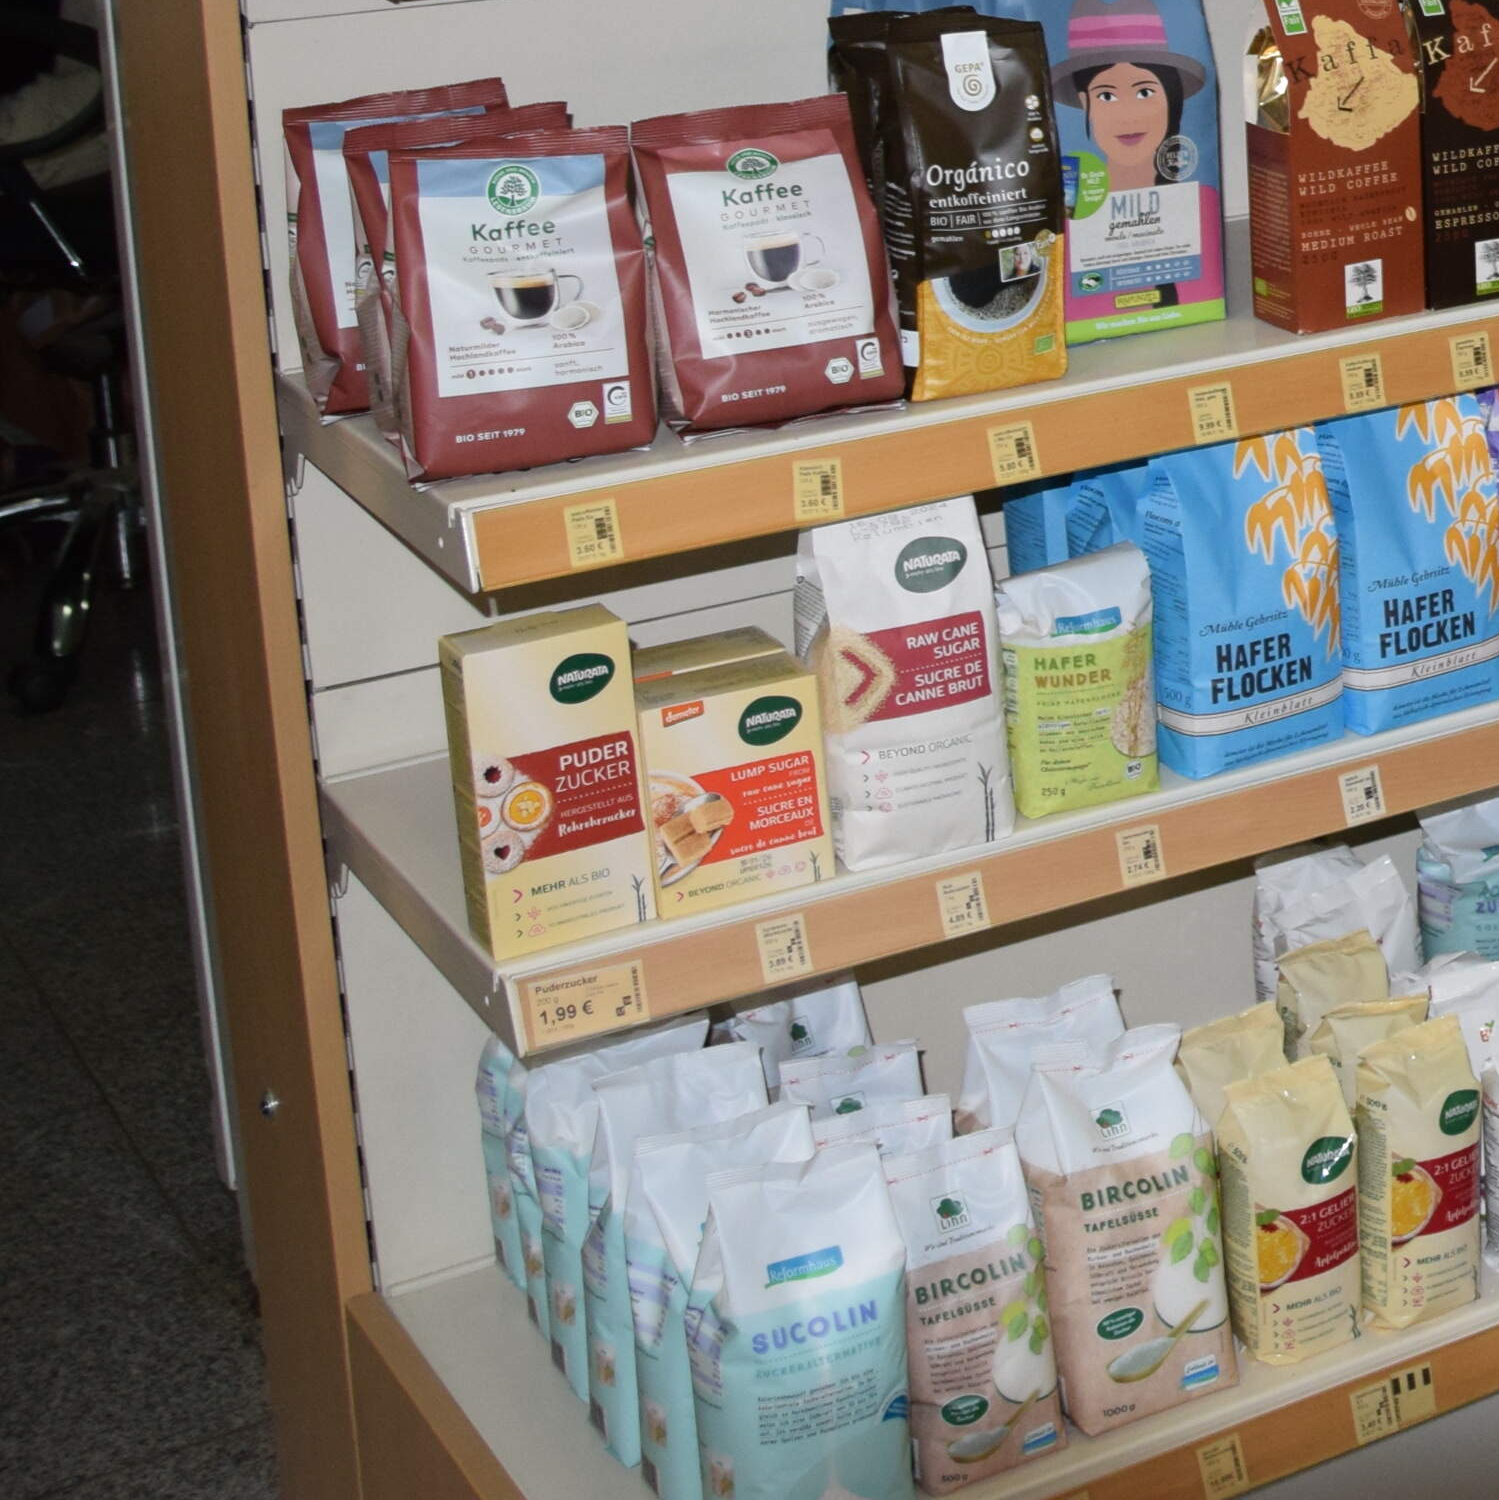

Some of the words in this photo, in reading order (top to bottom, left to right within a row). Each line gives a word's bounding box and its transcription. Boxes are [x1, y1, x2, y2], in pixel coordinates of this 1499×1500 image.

[954, 64, 981, 75] GEPA
[1288, 34, 1404, 83] Kaffa
[925, 158, 1029, 189] Orgánico
[929, 189, 1027, 210] entkoffeiniert
[1112, 192, 1160, 219] MILD
[472, 217, 555, 242] Kaffee
[930, 216, 947, 227] BIO
[956, 214, 975, 226] FAIR
[470, 238, 564, 256] GOURMET
[1301, 236, 1355, 252] MEDIUM
[1363, 226, 1403, 243] ROAST
[455, 433, 476, 443] BIO
[478, 431, 500, 442] SEIT
[503, 428, 525, 440] 1979
[907, 636, 938, 650] RAW
[943, 623, 978, 640] CANE
[934, 639, 980, 659] SUGAR
[1035, 654, 1096, 669] HAFER
[1216, 633, 1291, 672] HAFER
[916, 668, 954, 686] SUCRE
[960, 661, 982, 675] DE
[1035, 671, 1111, 687] WUNDER
[1211, 657, 1312, 703] FLOCKEN
[896, 690, 939, 706] CANNE
[945, 677, 983, 693] BRUT
[665, 706, 700, 721] demeter
[560, 741, 627, 770] PUDER
[555, 761, 630, 793] ZUCKER
[731, 767, 764, 781] LUMP
[769, 757, 808, 771] SUGAR
[1042, 788, 1057, 796] 250
[749, 808, 813, 831] MORCEAUX
[758, 803, 791, 817] SUCRE
[796, 799, 812, 811] EN
[559, 808, 637, 837] Rohrohrzucker
[535, 976, 597, 996] Puderzucker
[539, 1004, 576, 1026] 1,99
[582, 1000, 593, 1015] €
[771, 1255, 839, 1284] Reformhaus
[915, 1254, 1025, 1305] BIRCOLIN
[920, 1297, 996, 1325] TAFELSÜSSE
[752, 1301, 877, 1355] SUCOLIN
